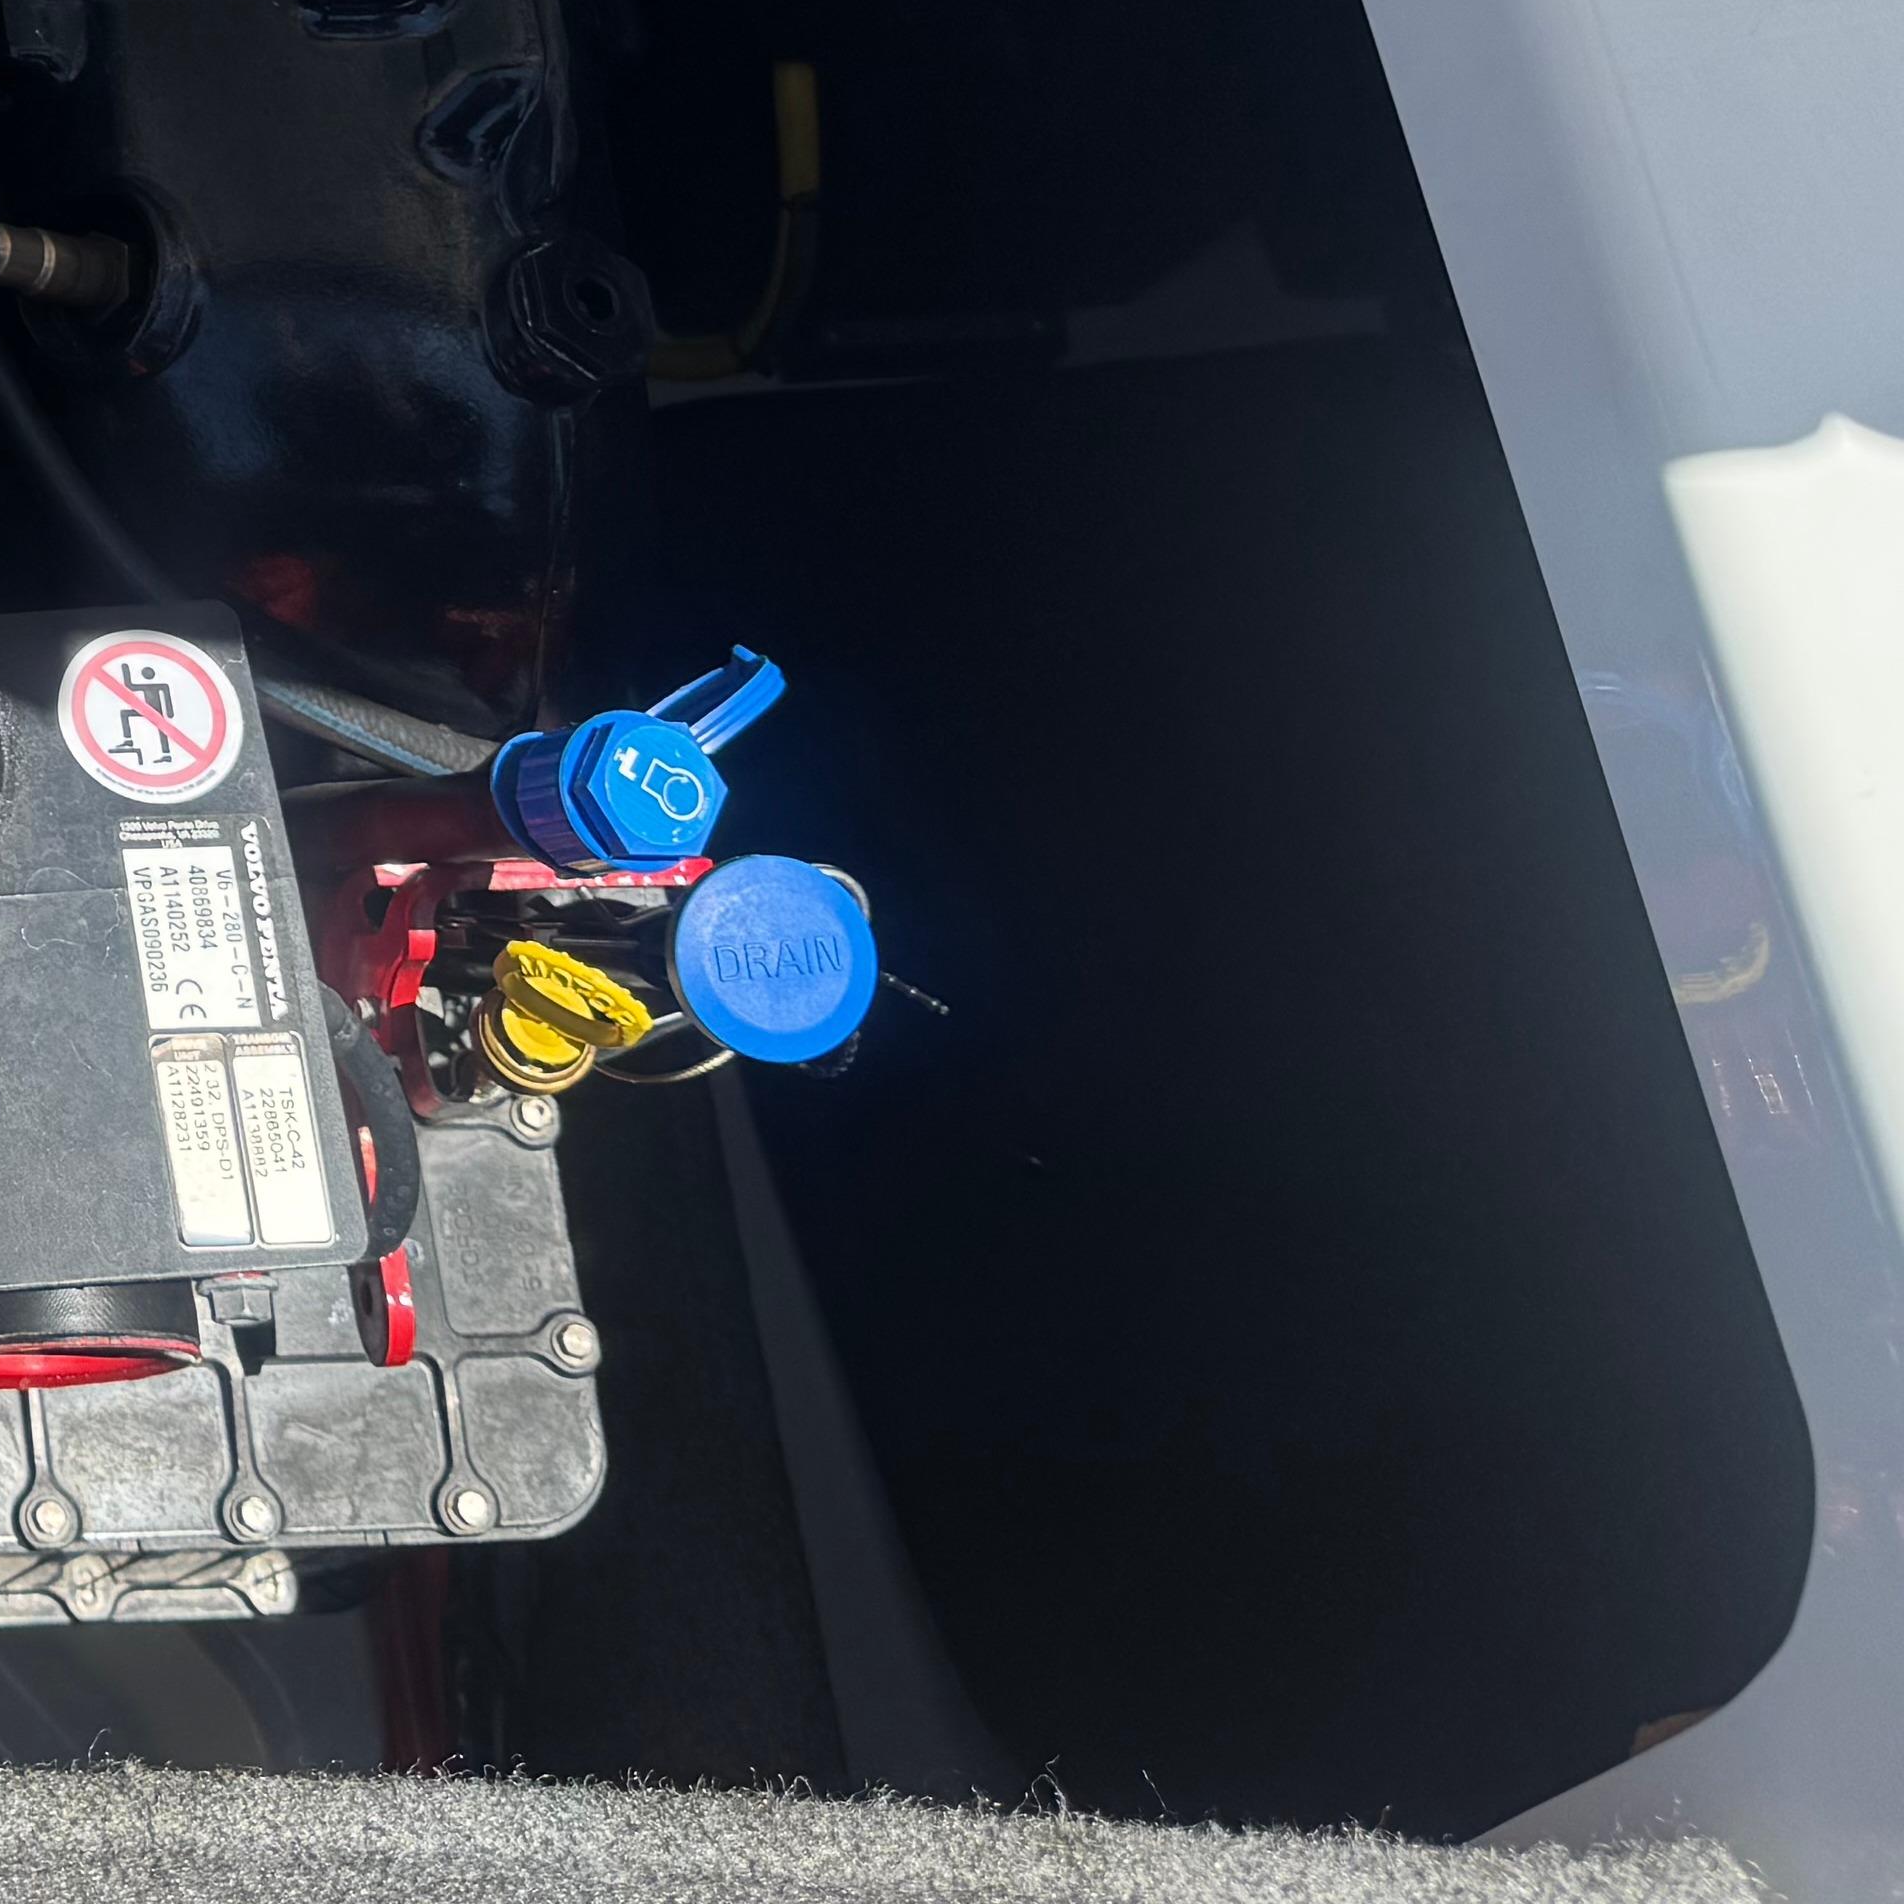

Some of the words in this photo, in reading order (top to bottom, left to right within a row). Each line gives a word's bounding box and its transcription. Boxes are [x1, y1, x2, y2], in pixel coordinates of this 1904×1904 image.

[159, 866, 191, 953] A1140252
[189, 865, 218, 949] 40869834
[241, 820, 272, 916] VOLVO
[133, 866, 169, 993] VPGAS090236
[256, 917, 289, 1021] PENTA
[713, 935, 842, 984] DRAIN
[175, 978, 208, 1020] CE
[167, 1065, 192, 1152] A1128231
[212, 1112, 234, 1180] DPS-D1
